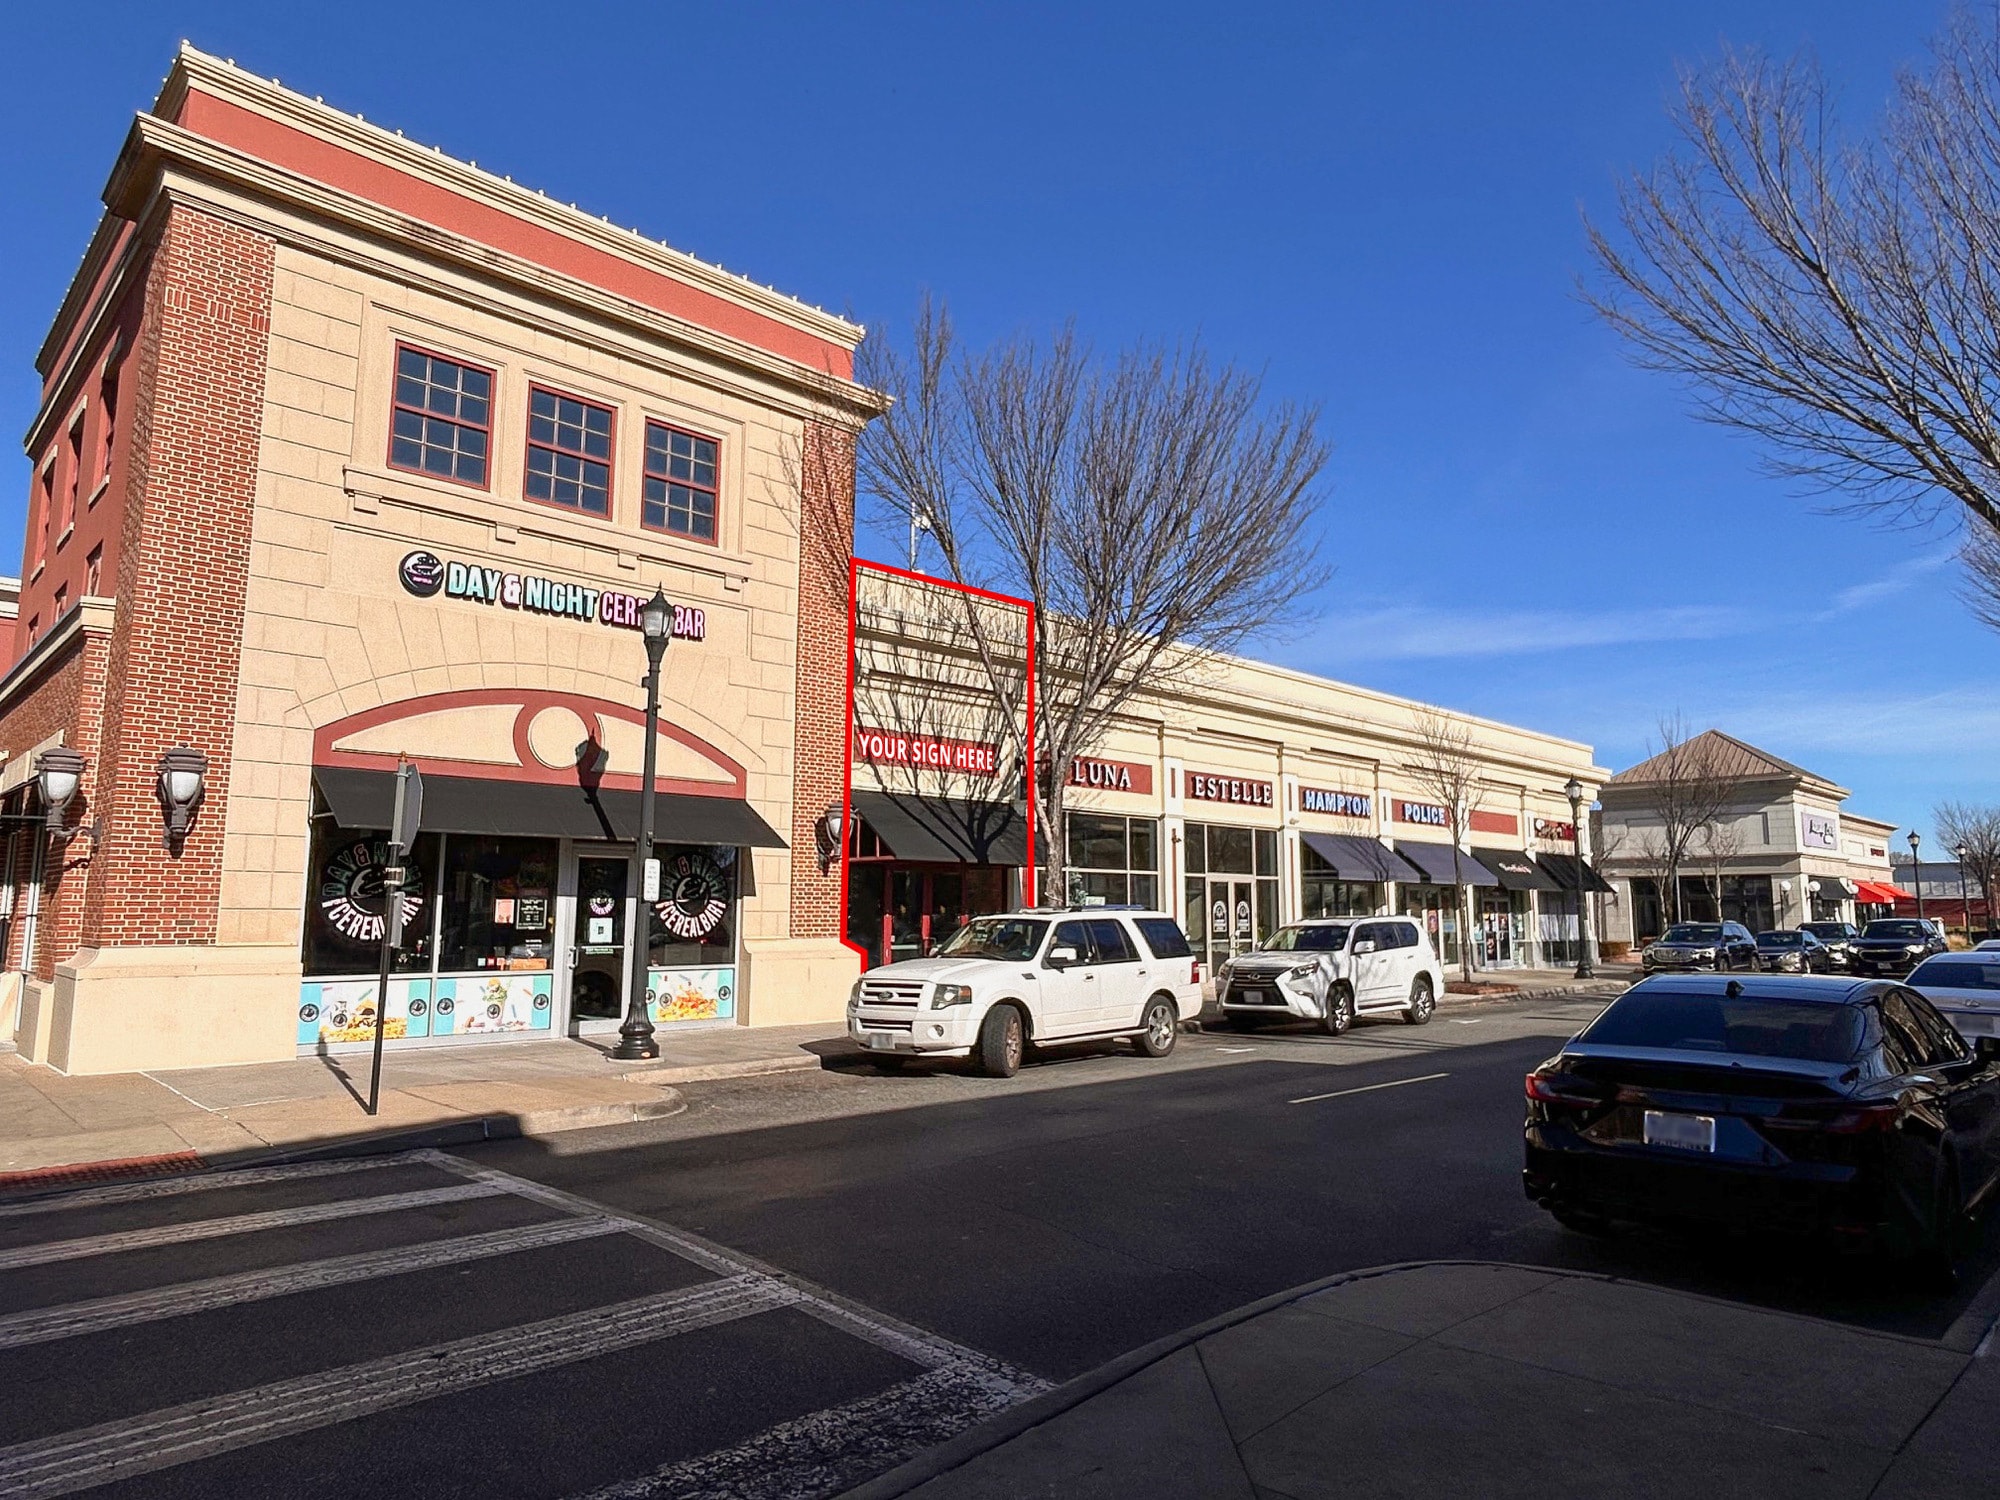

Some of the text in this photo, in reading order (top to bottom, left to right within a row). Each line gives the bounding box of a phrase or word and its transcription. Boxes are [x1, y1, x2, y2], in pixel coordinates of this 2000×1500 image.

[446, 561, 502, 603] DAY
[501, 573, 521, 608] &
[524, 577, 599, 620] NIGHT
[674, 605, 705, 639] BAR
[1074, 759, 1132, 788] LUNA
[1195, 775, 1272, 805] ESTELLE
[1304, 789, 1371, 816] HAMPTON
[1404, 803, 1446, 825] POLICE
[322, 850, 358, 896] DAY
[659, 902, 724, 938] CEREAL BAR
